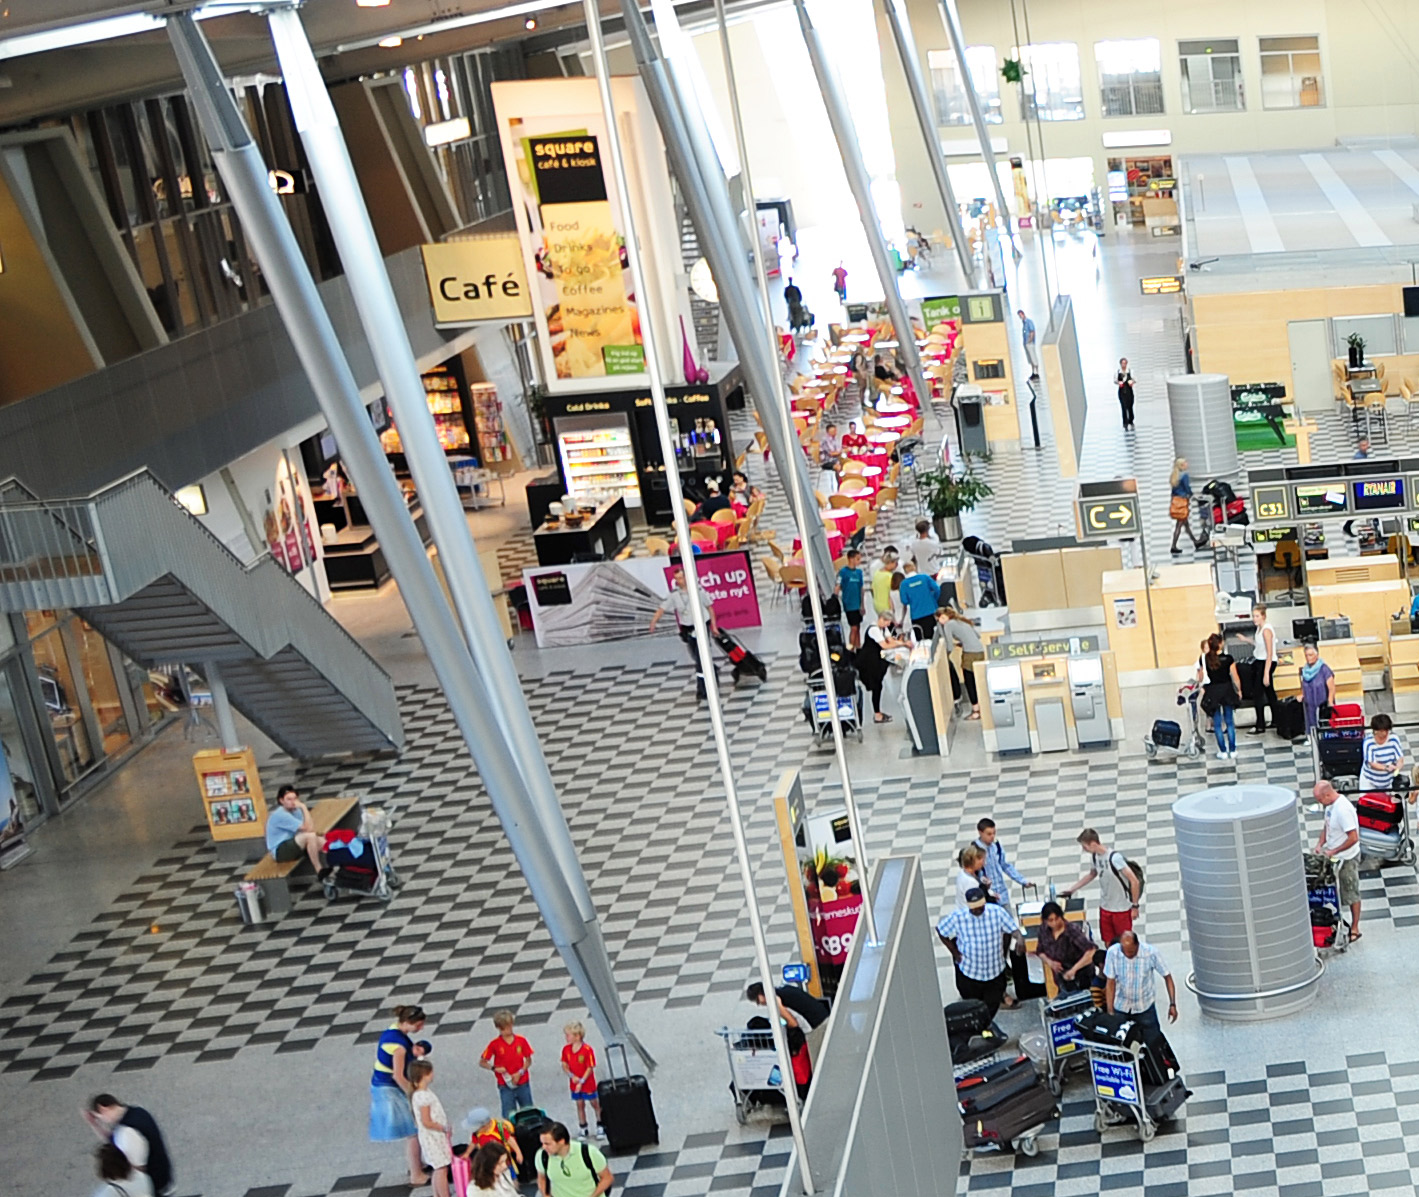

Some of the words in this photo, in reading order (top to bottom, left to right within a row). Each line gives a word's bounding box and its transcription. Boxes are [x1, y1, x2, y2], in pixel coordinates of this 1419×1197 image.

[534, 140, 595, 158] square
[549, 221, 580, 233] Food
[553, 243, 593, 255] Drinks
[439, 272, 521, 302] Café
[562, 285, 603, 297] Coffee
[566, 304, 625, 318] Magazines
[923, 307, 950, 318] Tank
[569, 326, 601, 338] News
[1363, 480, 1397, 497] RYANAIR
[1260, 502, 1285, 517] C31
[1090, 505, 1108, 530] C
[724, 569, 747, 585] up
[1008, 639, 1090, 657] Self-Serve
[1052, 1023, 1072, 1034] Free
[1094, 1063, 1111, 1075] Free
[1112, 1065, 1133, 1079] Wi-Fi
